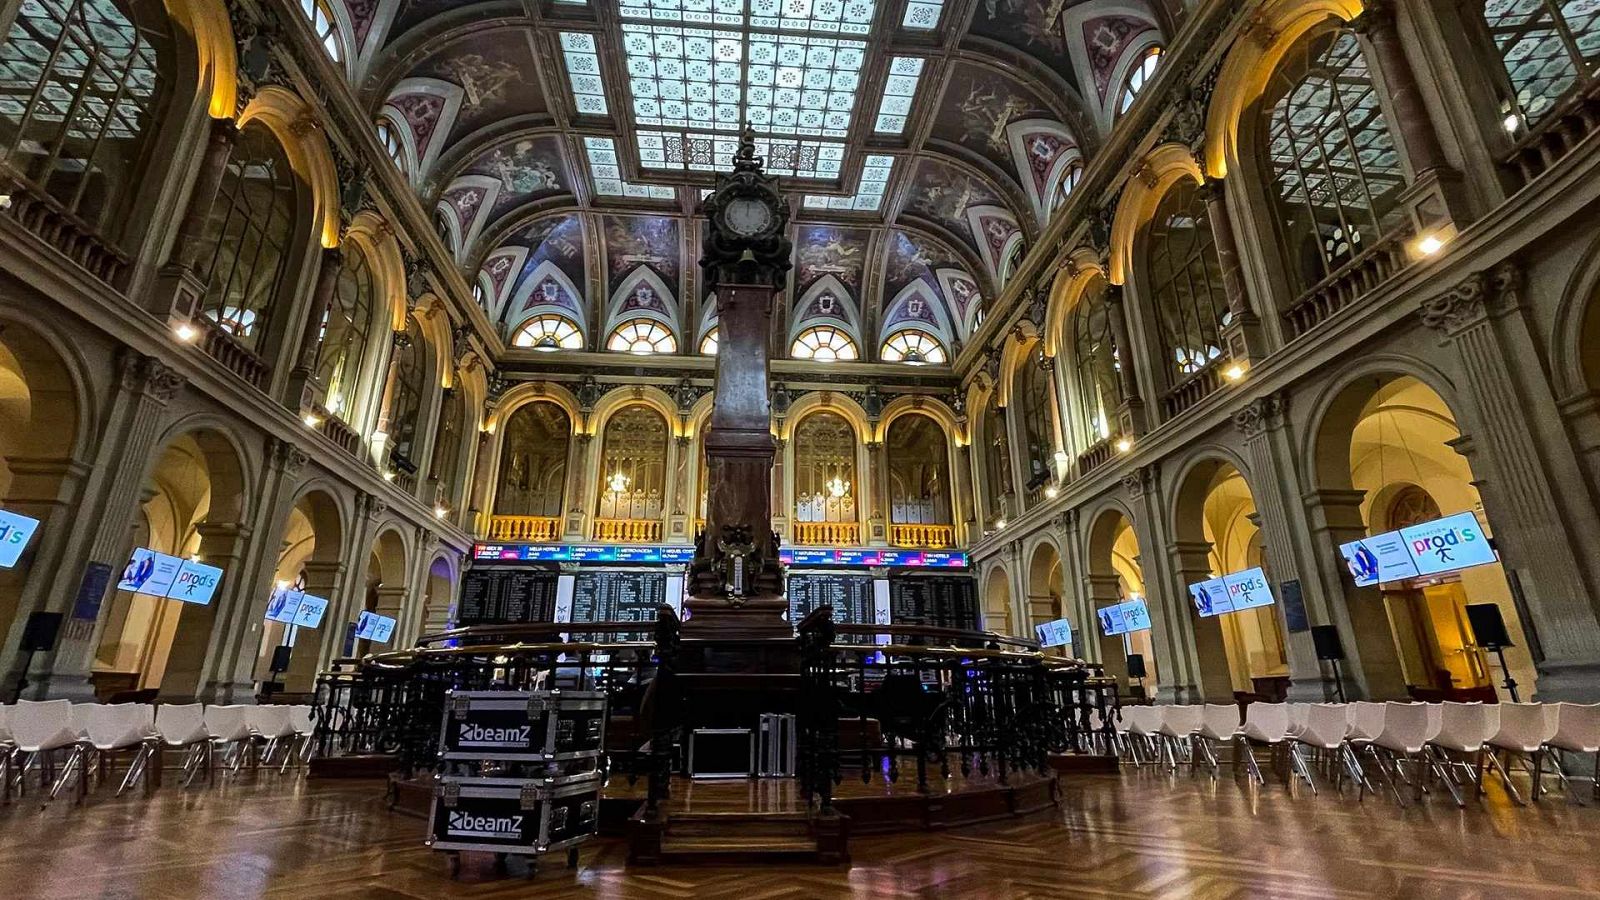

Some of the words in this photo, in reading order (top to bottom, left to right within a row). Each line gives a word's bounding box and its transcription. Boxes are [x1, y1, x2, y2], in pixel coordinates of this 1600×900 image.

[1413, 528, 1476, 556] prodis
[178, 571, 216, 588] prodis
[1229, 578, 1264, 596] prodis
[473, 723, 531, 742] beamZ
[463, 811, 523, 832] beamZ
